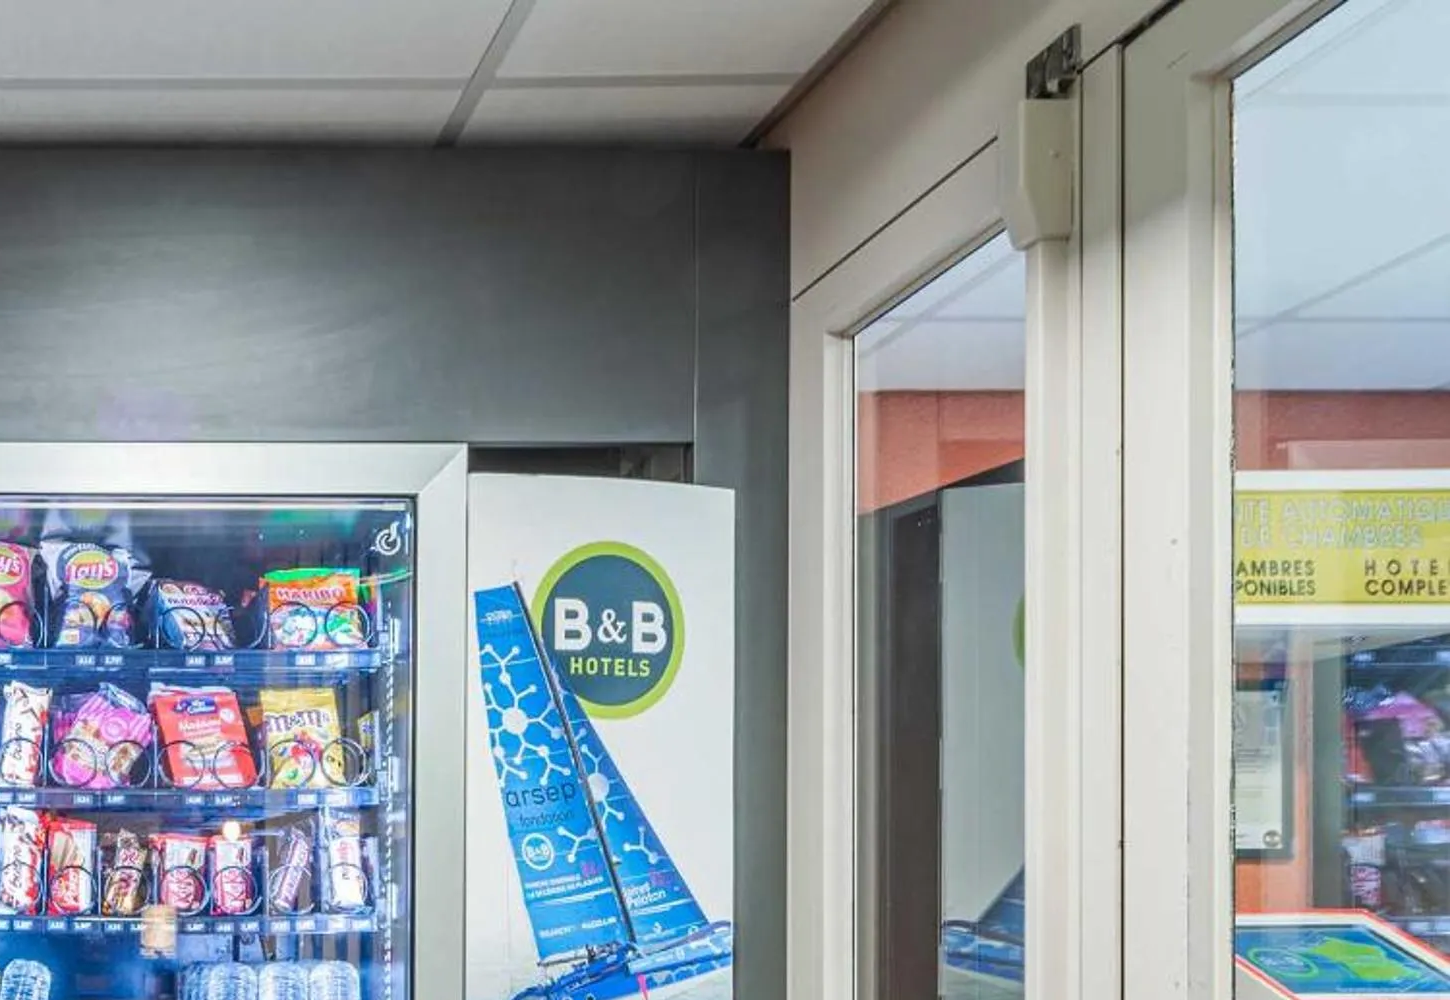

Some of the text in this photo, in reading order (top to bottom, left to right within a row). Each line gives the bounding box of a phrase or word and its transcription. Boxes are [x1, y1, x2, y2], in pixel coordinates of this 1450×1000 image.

[1364, 579, 1447, 596] COMPLE
[554, 597, 668, 655] B&B
[570, 656, 651, 678] HOTELS
[505, 782, 576, 807] arsep
